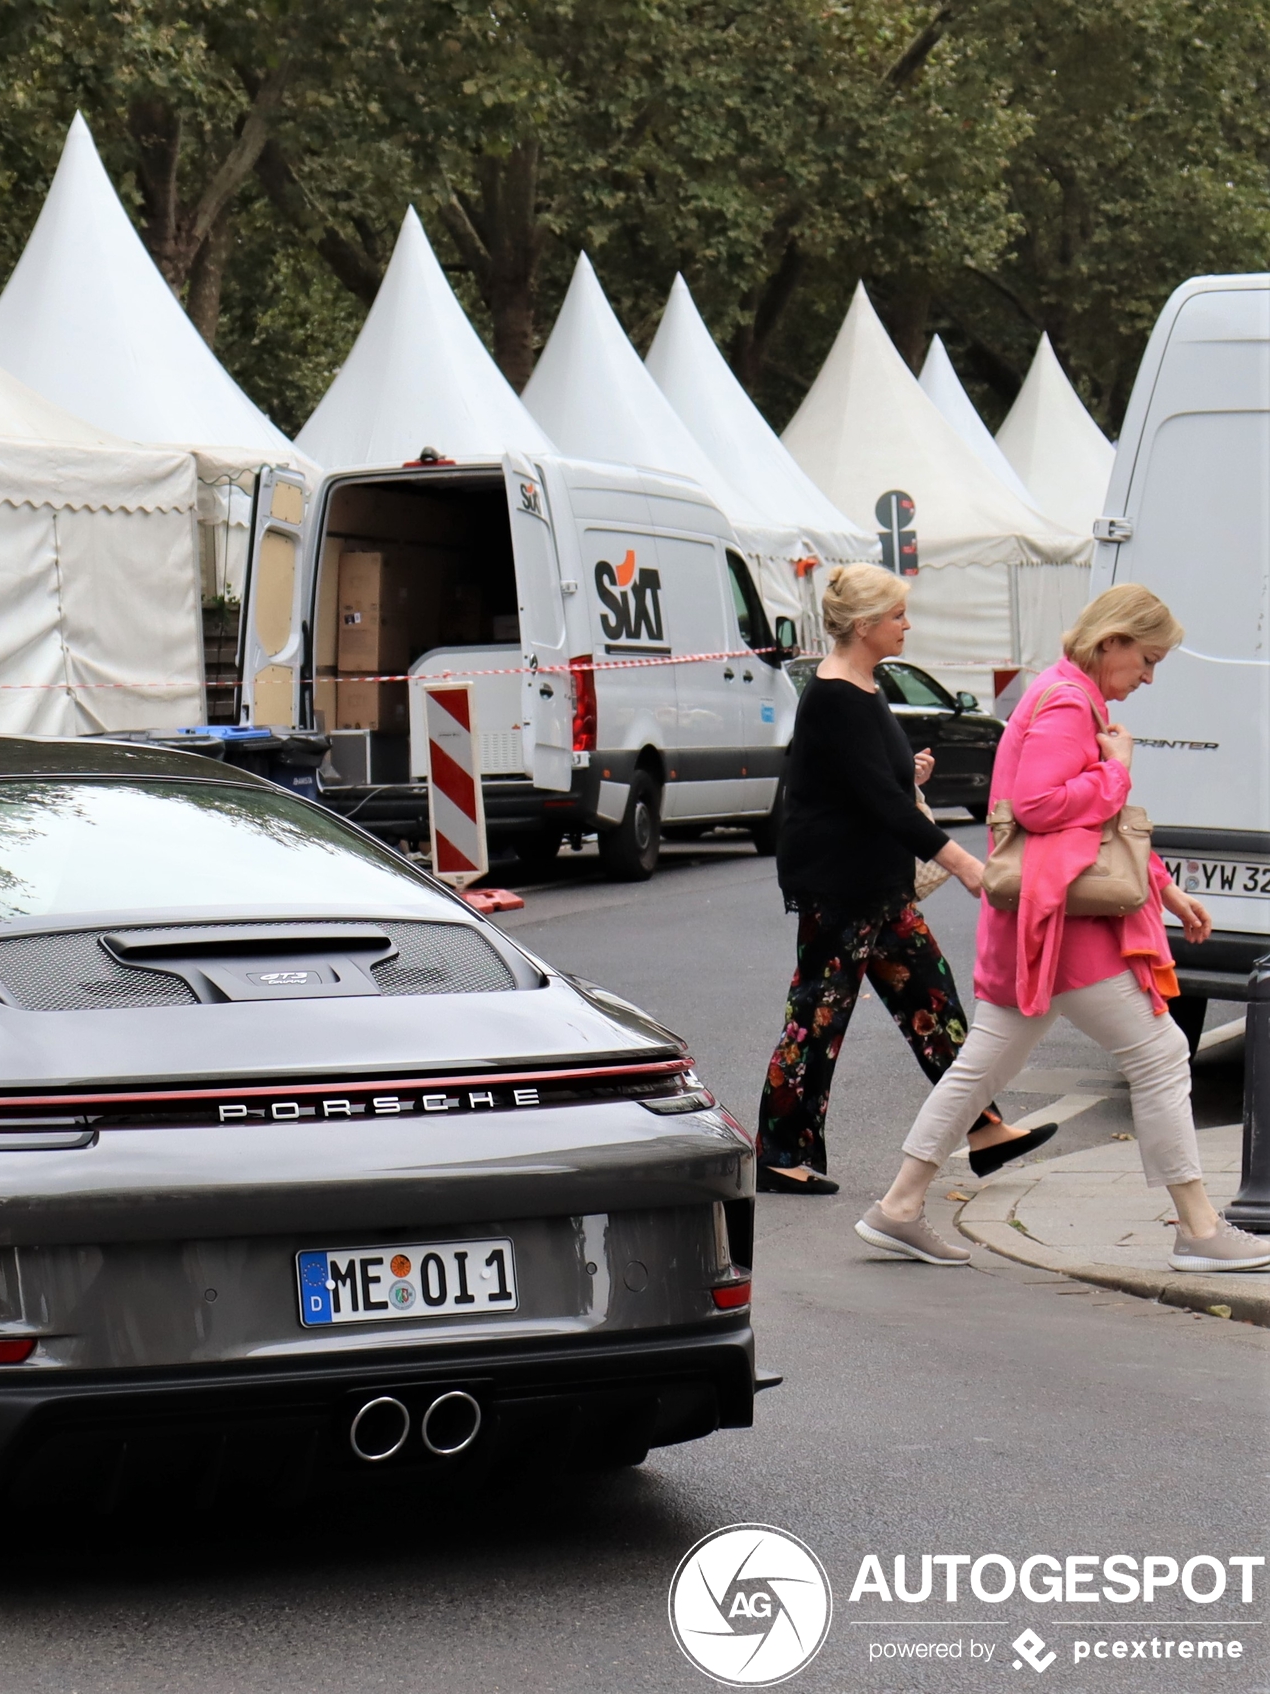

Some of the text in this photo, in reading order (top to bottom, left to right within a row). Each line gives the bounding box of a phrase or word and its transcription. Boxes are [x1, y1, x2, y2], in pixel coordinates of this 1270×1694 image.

[1132, 738, 1220, 751] PRINTER
[1201, 863, 1238, 891] YW
[259, 972, 308, 981] GT3
[218, 1088, 540, 1122] PORSCHE
[310, 1296, 323, 1312] D
[330, 1257, 389, 1313] ME
